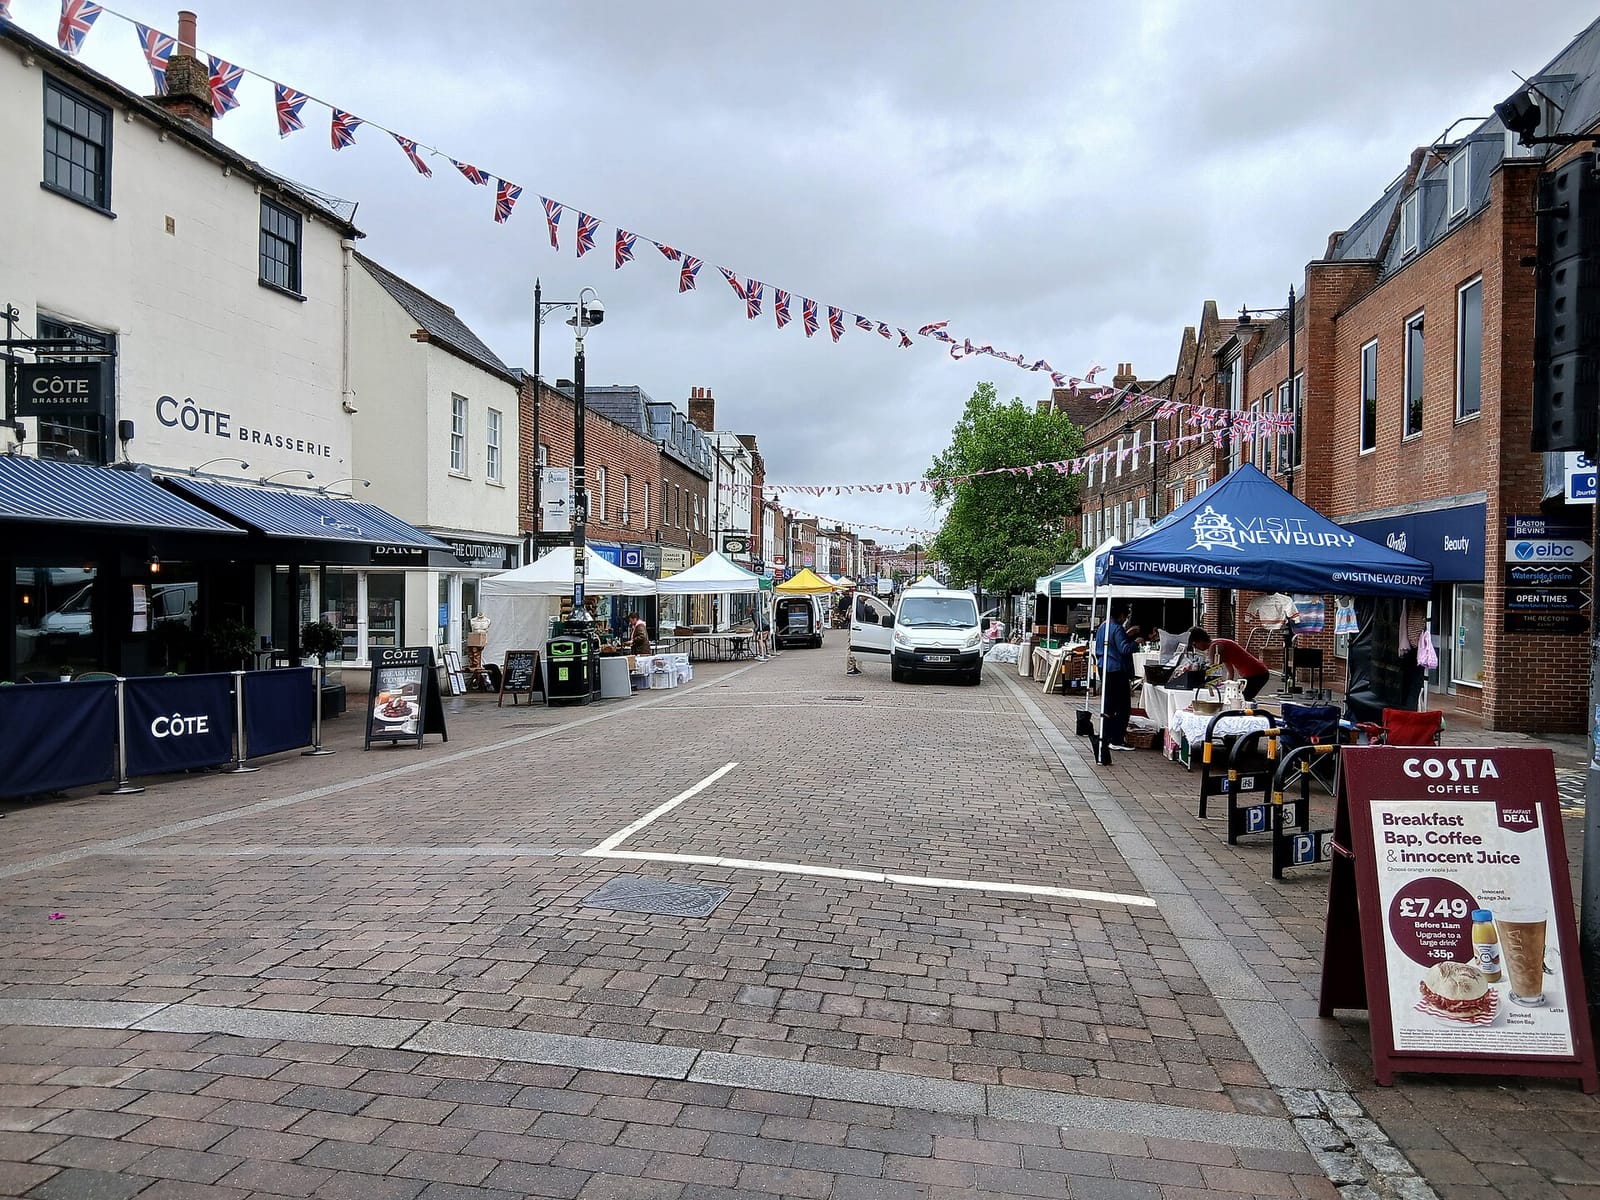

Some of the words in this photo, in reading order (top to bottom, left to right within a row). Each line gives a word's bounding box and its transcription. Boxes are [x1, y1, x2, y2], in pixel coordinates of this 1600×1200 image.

[32, 376, 89, 394] CÔTE
[155, 395, 231, 438] CÔTE
[239, 427, 331, 457] BRASSERIE
[1234, 516, 1308, 532] VISIT
[1238, 530, 1355, 547] NEWBURY
[1444, 535, 1470, 555] Beauty
[466, 544, 490, 558] CUTTING
[1118, 561, 1240, 576] VISITNEWBURY.ORG.UK
[1511, 572, 1548, 580] Waterside
[1332, 572, 1424, 586] @VISITNEWBURY
[1516, 595, 1540, 603] OPEN
[382, 648, 419, 660] CÔTE
[151, 713, 209, 738] CÔTE
[1403, 758, 1499, 781] COSTA
[1427, 785, 1480, 794] COFFEE
[1250, 809, 1262, 831] P
[1382, 812, 1464, 827] Breakfast
[1503, 814, 1533, 823] DEAL
[1384, 831, 1422, 846] Bap,
[1425, 831, 1482, 845] Coffee
[1297, 837, 1312, 862] P
[1386, 849, 1398, 863] &
[1400, 849, 1474, 863] innocent
[1477, 850, 1521, 865] Juice
[1400, 898, 1468, 918] £7.49
[1415, 931, 1446, 939] Upgrade
[1427, 950, 1454, 960] +35p
